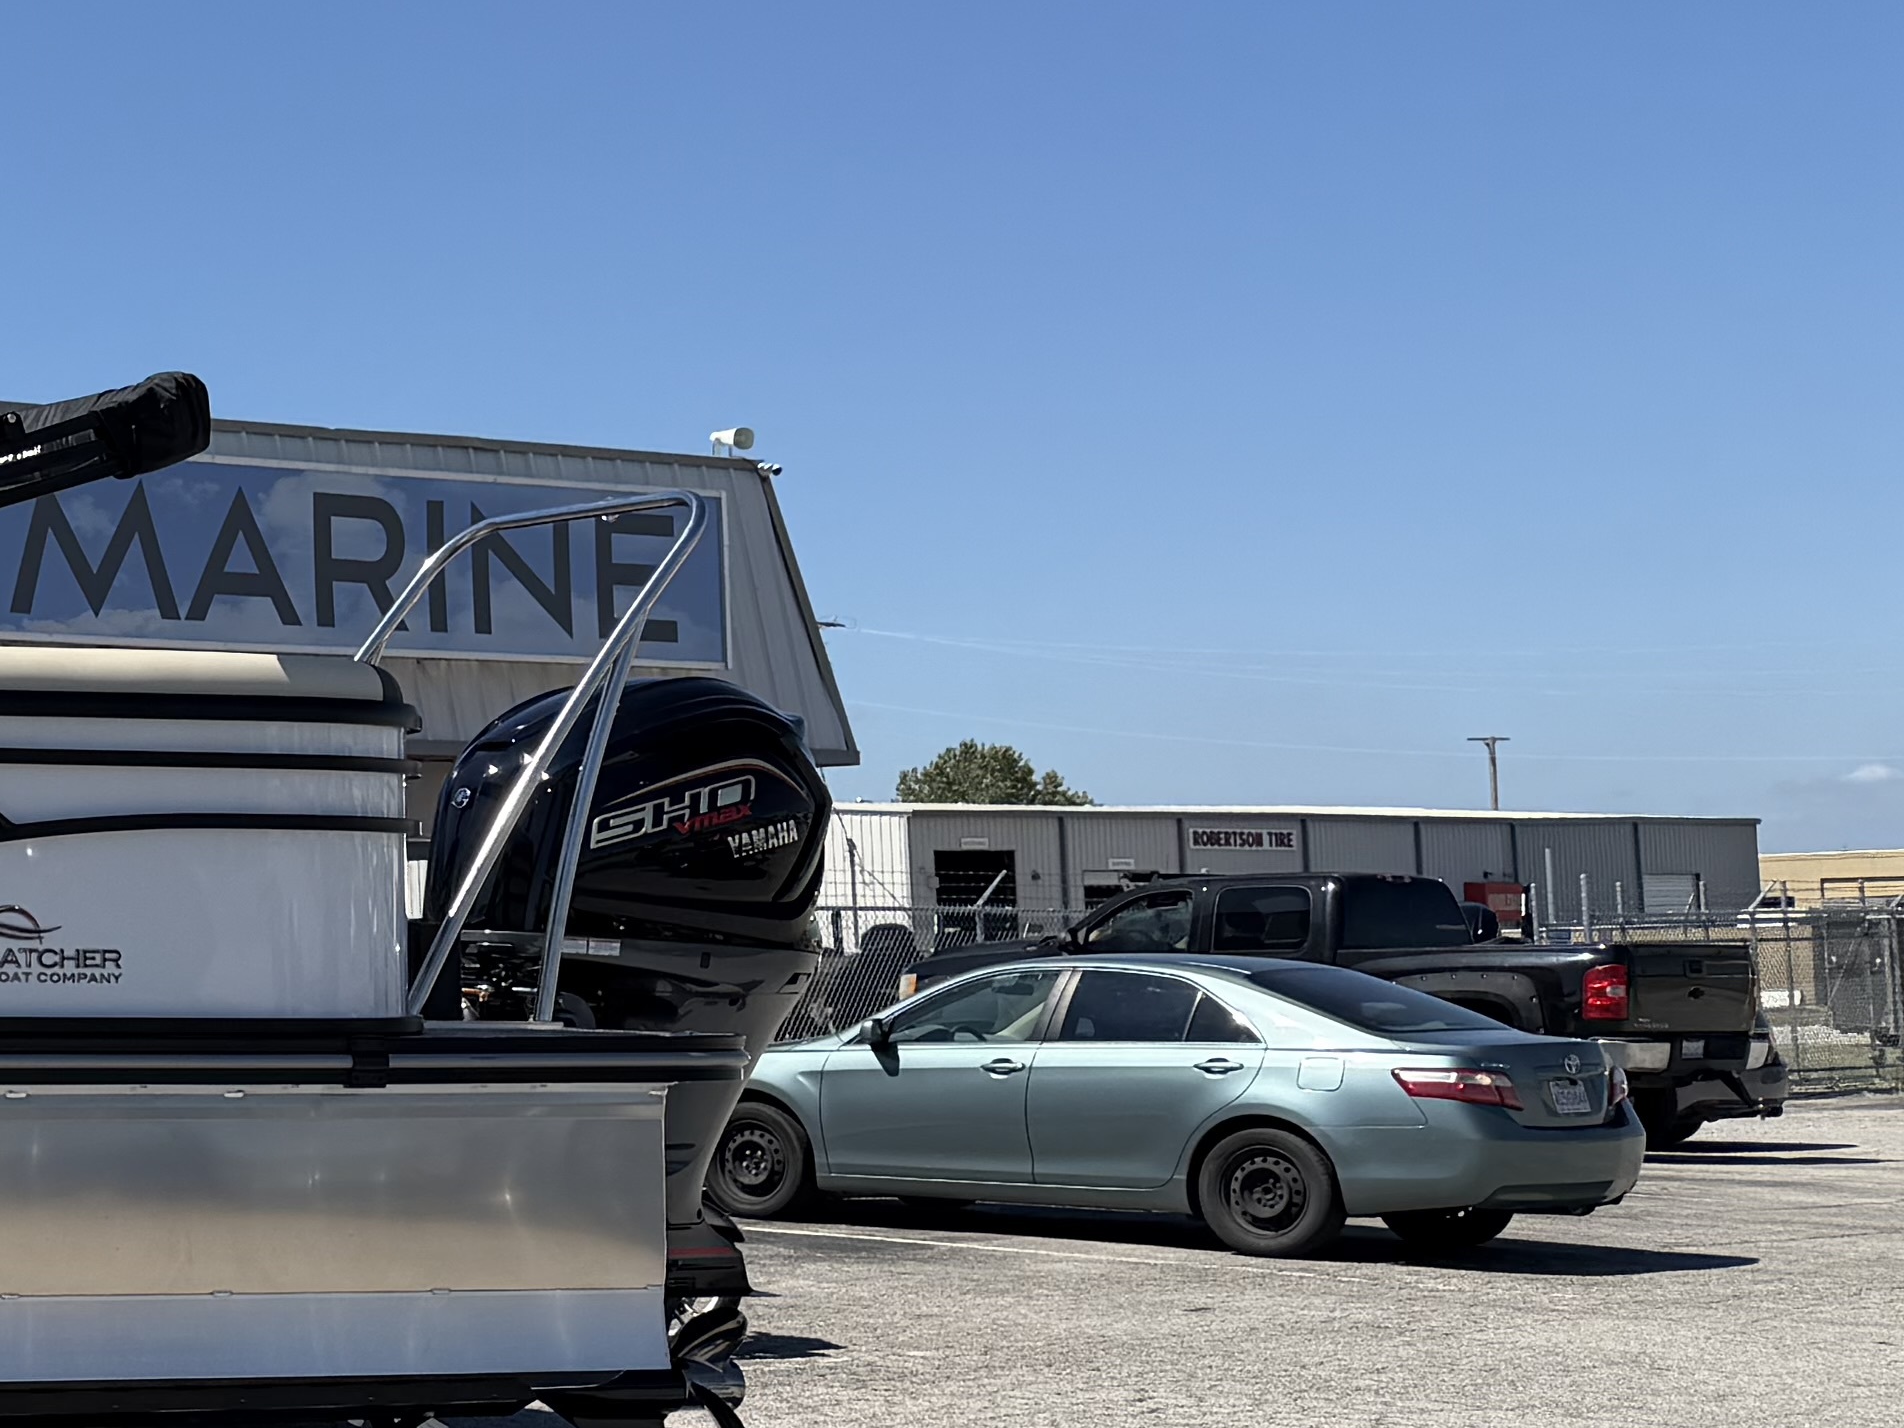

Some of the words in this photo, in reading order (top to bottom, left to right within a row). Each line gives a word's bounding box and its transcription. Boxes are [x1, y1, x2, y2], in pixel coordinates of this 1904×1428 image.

[9, 479, 679, 644] MARINE
[589, 774, 756, 850] SHO
[726, 818, 800, 859] YAMAHA
[1192, 830, 1264, 848] ROBERTSON
[1266, 830, 1294, 848] TIRE
[36, 971, 123, 984] COMPANY
